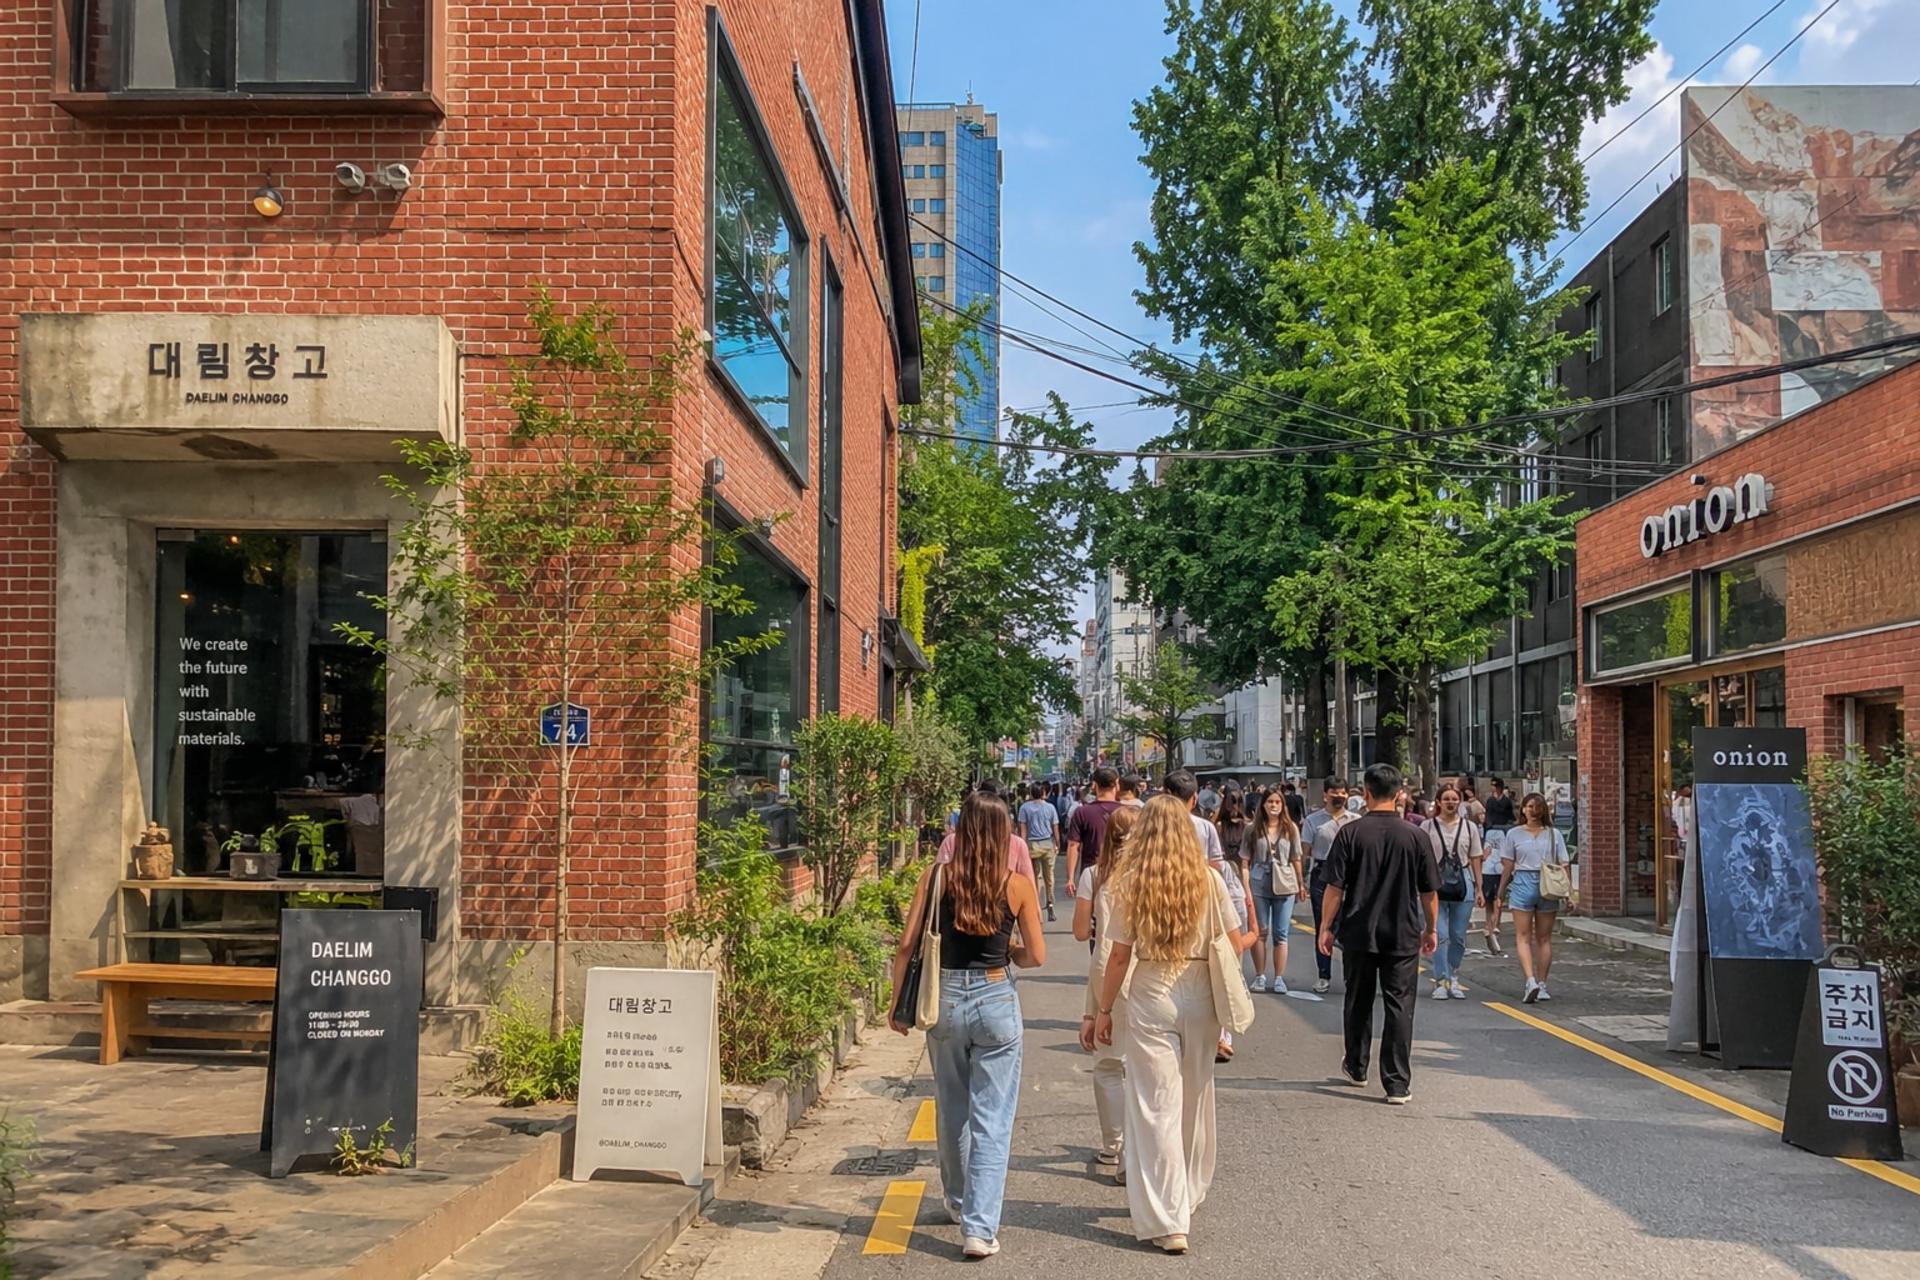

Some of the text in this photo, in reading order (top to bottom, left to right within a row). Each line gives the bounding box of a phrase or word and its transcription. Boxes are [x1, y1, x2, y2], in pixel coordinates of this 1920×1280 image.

[148, 342, 328, 380] 대림창고
[185, 392, 228, 405] DAELIM
[1640, 472, 1768, 558] onion
[179, 637, 248, 651] We create
[179, 660, 248, 674] the future
[179, 684, 209, 698] with
[178, 708, 256, 722] sustainable
[178, 731, 245, 745] materials.
[552, 723, 577, 741] 74
[1713, 743, 1789, 767] onion
[311, 941, 373, 959] DAELIM
[310, 969, 391, 987] CHANGGO
[608, 997, 672, 1014] 대림창고
[1826, 1008, 1875, 1031] 금지
[1831, 1107, 1845, 1117] No
